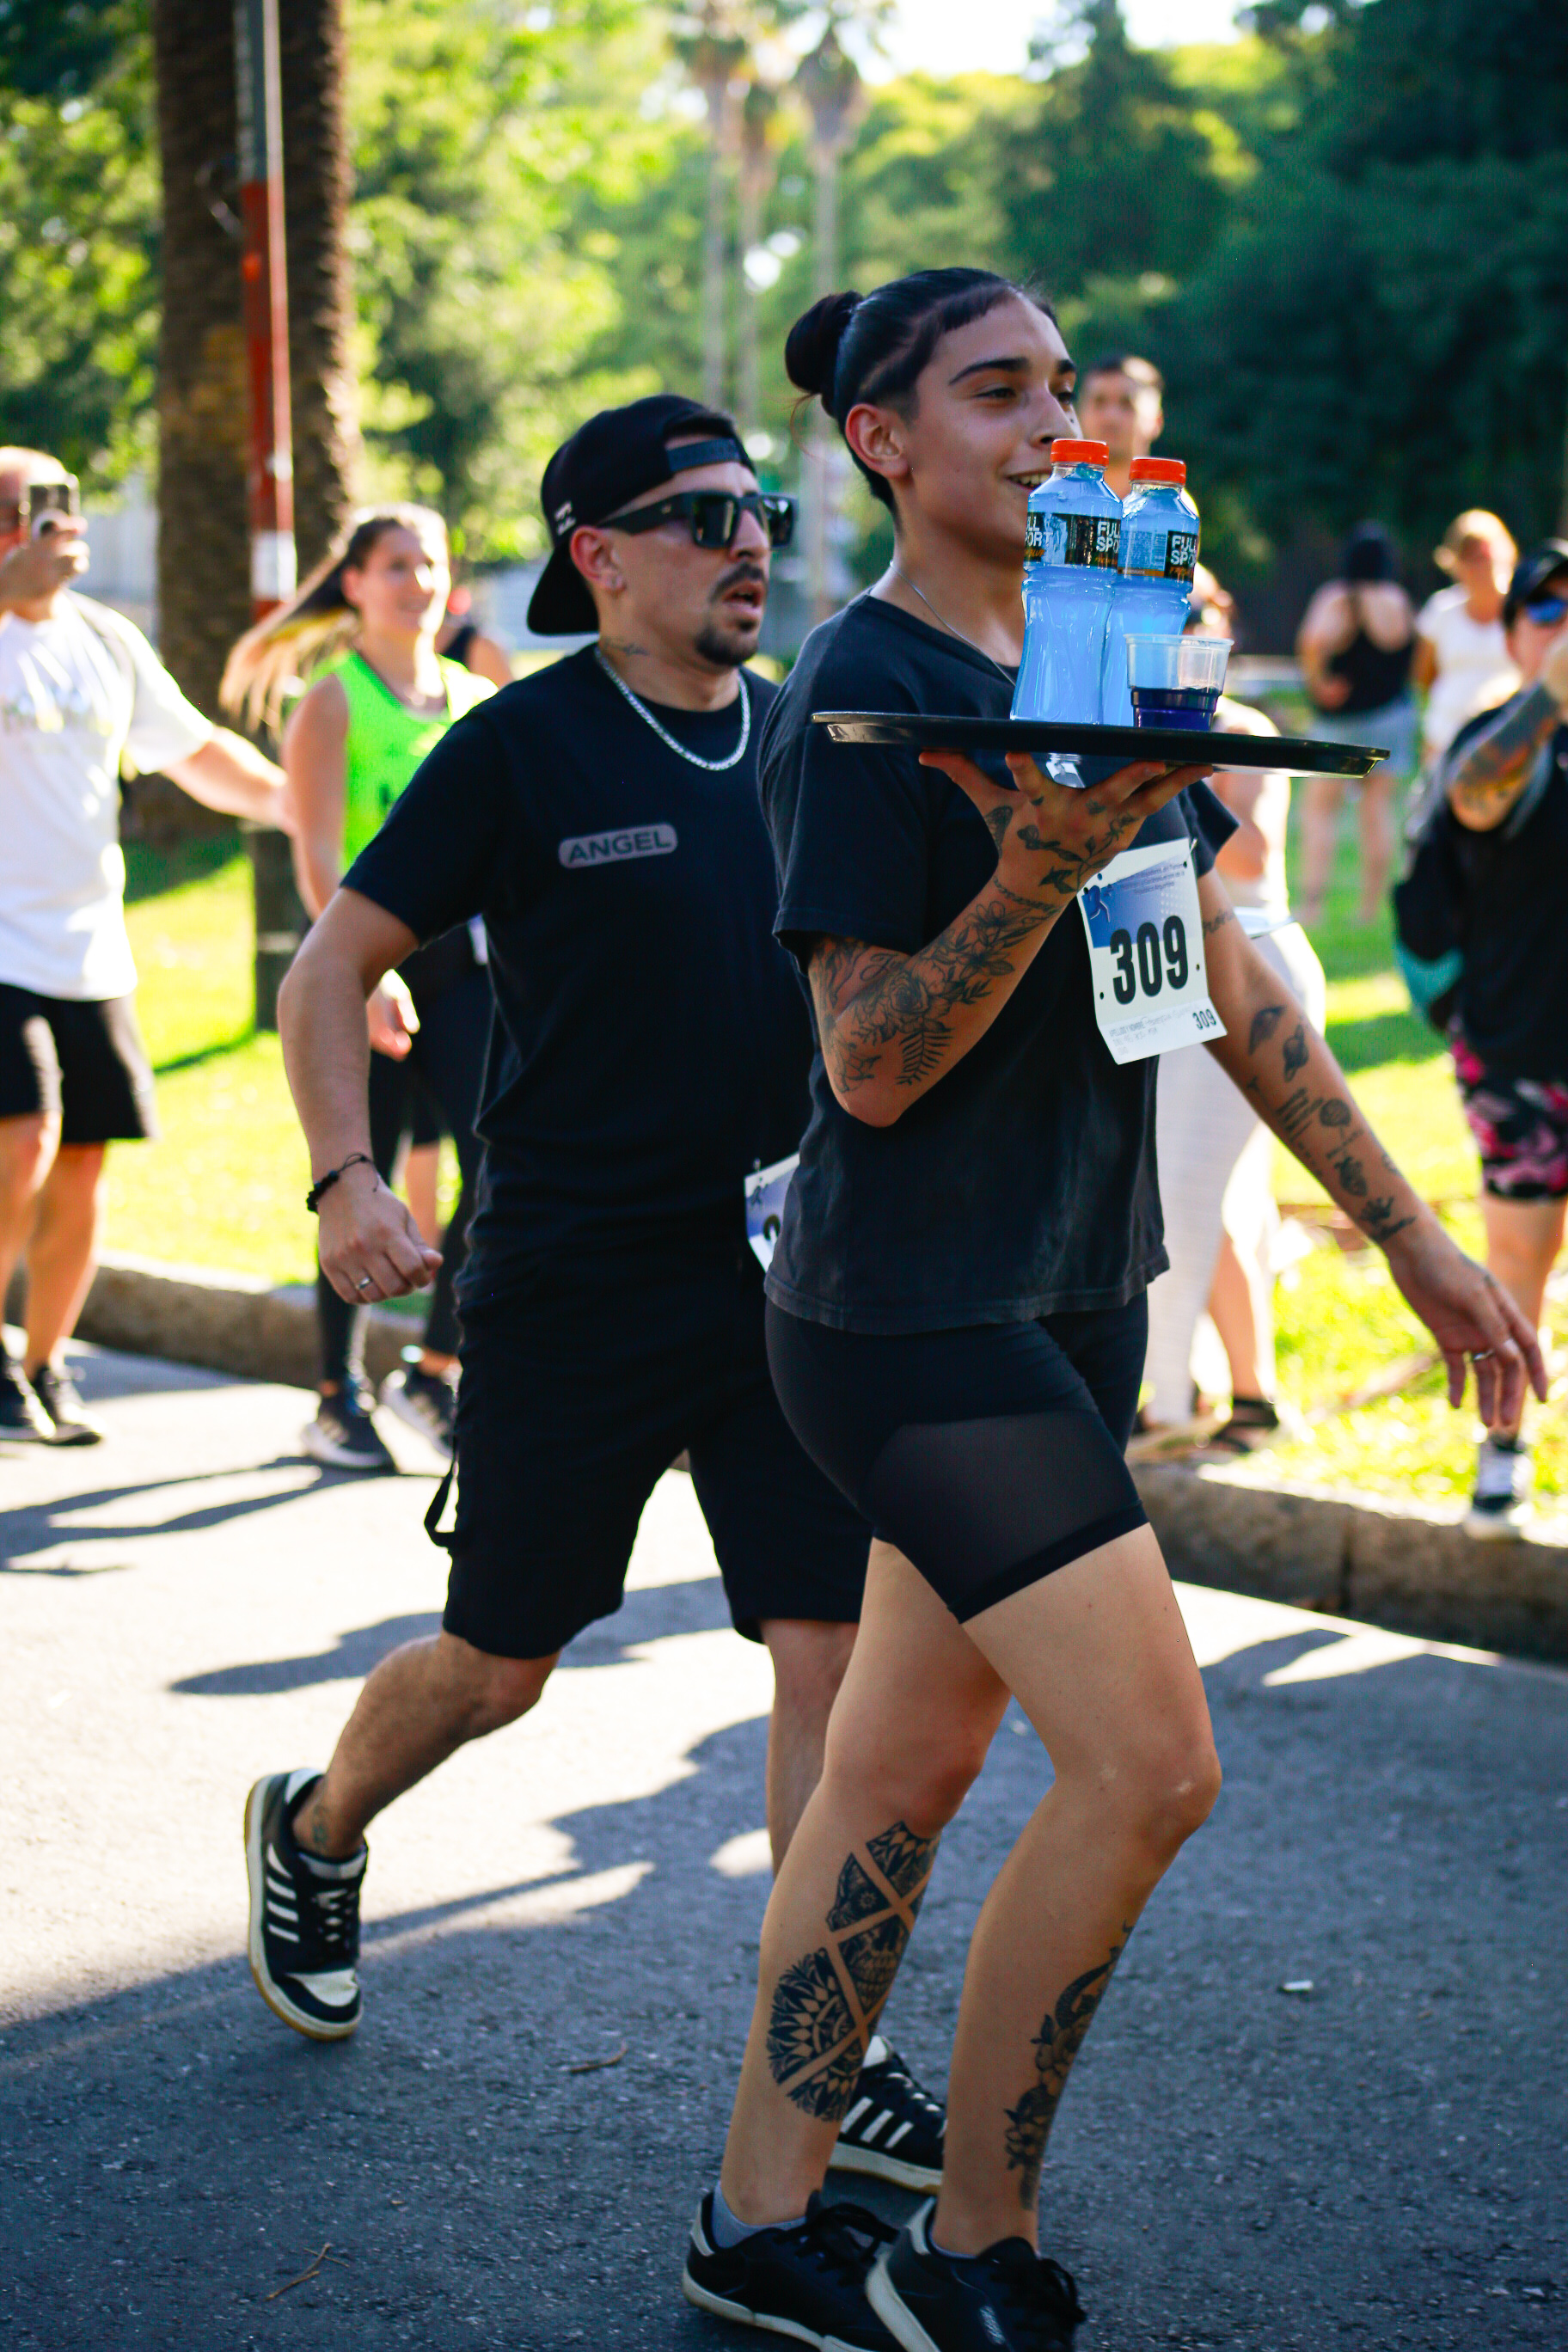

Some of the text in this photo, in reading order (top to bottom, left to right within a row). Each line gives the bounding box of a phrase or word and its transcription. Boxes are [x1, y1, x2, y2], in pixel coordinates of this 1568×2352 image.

[567, 830, 671, 864] ANGEL
[1110, 915, 1189, 1005] 309
[1192, 1008, 1217, 1030] 309
